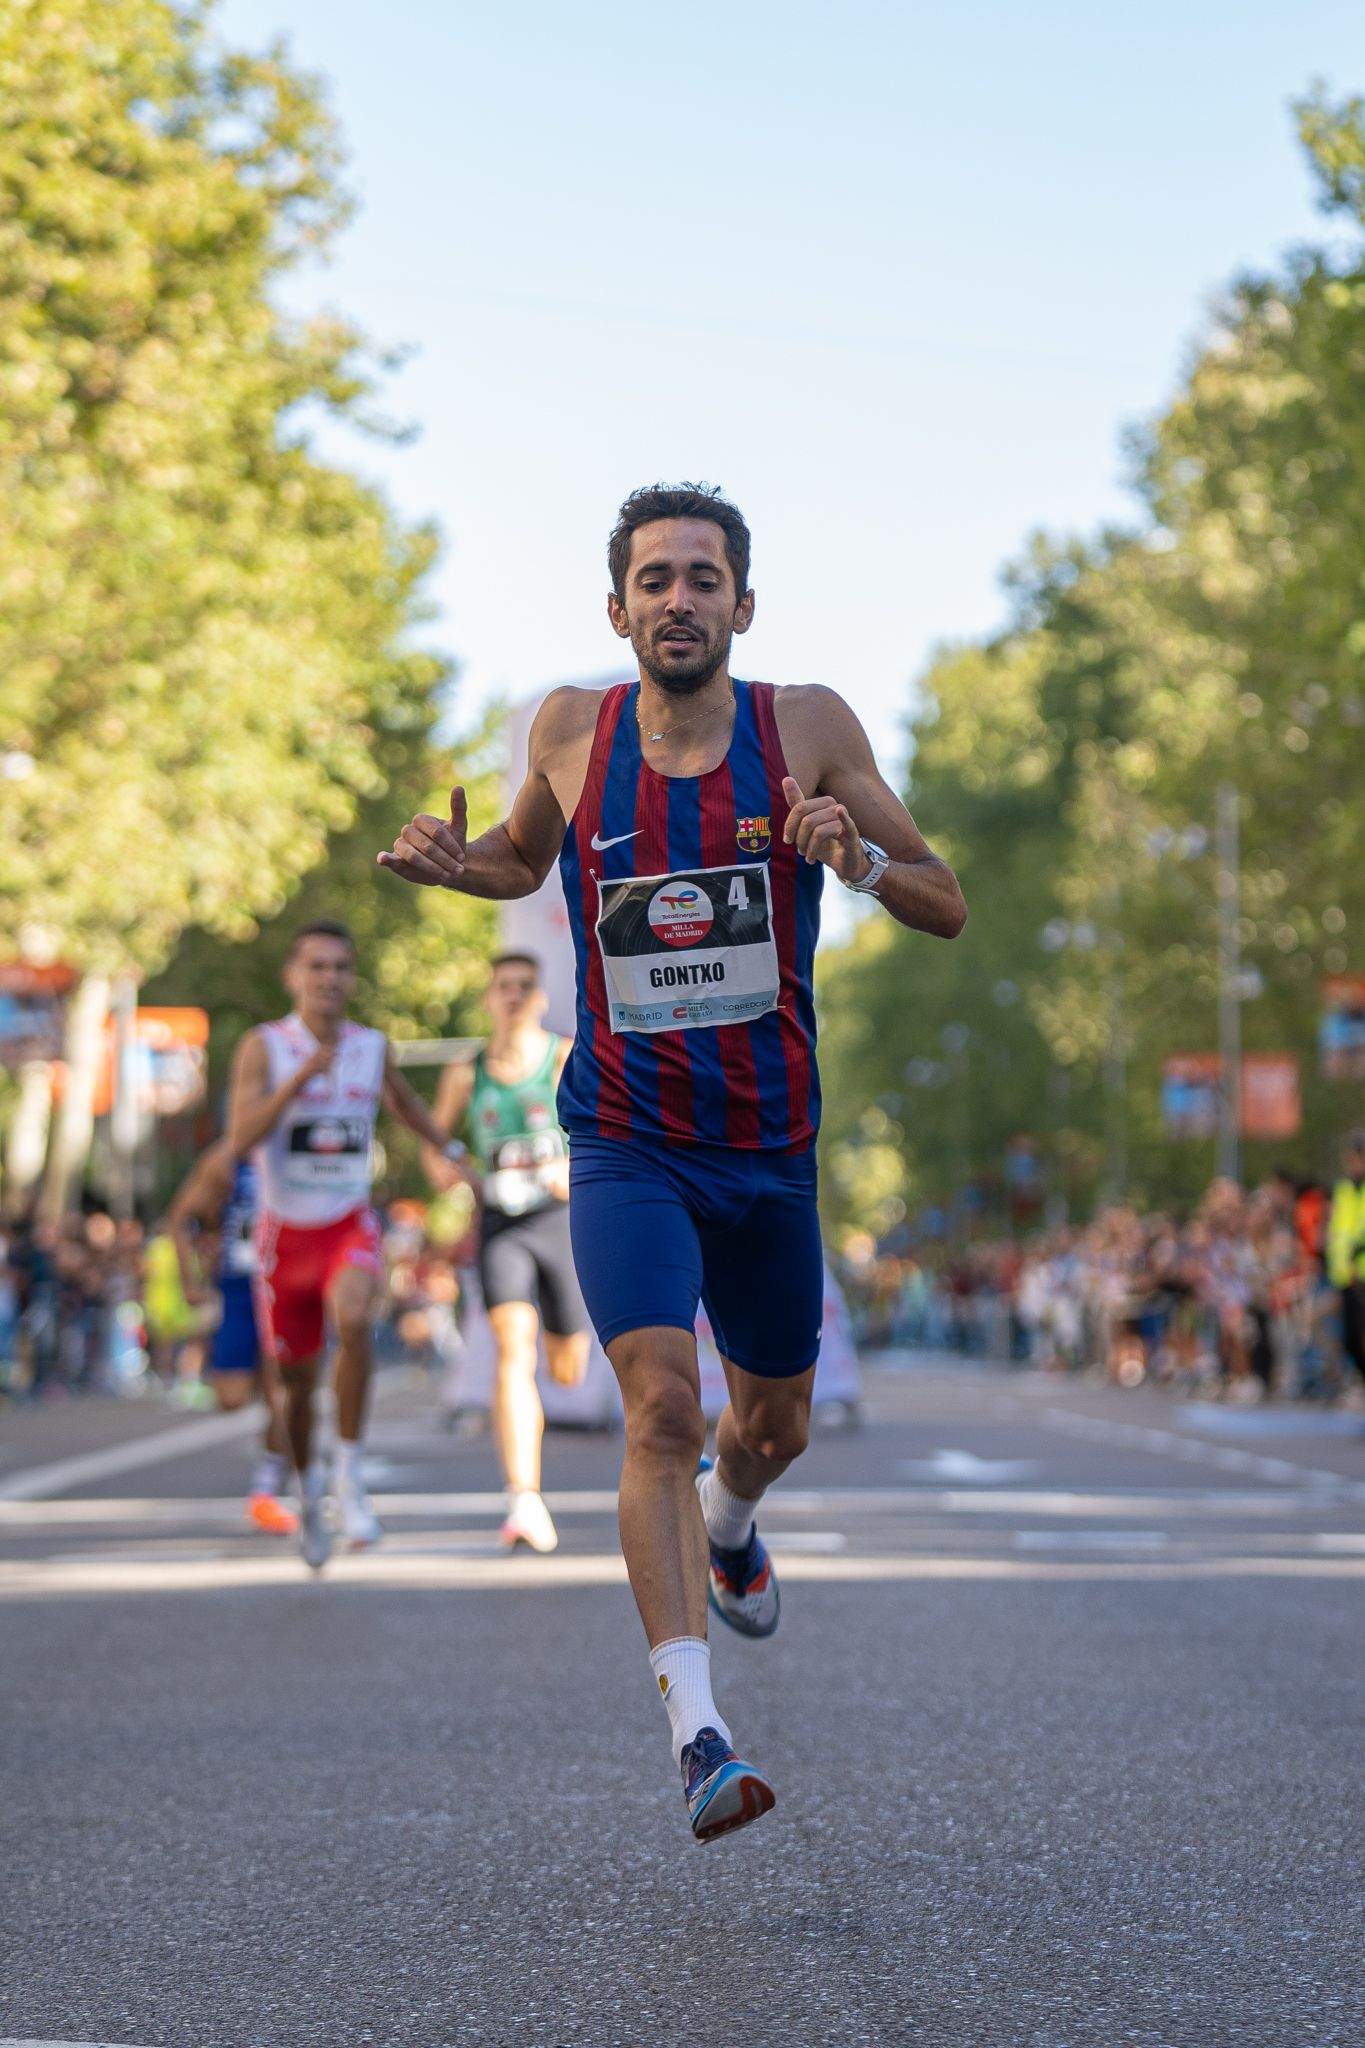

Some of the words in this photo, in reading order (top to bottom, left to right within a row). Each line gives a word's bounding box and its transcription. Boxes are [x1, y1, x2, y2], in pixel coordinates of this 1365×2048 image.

[728, 876, 750, 910] 4
[662, 912, 700, 920] TotalEnergies
[672, 924, 694, 932] MILLA
[676, 929, 704, 938] MADRID
[650, 962, 725, 988] GONTXO
[629, 1011, 663, 1021] MADRID
